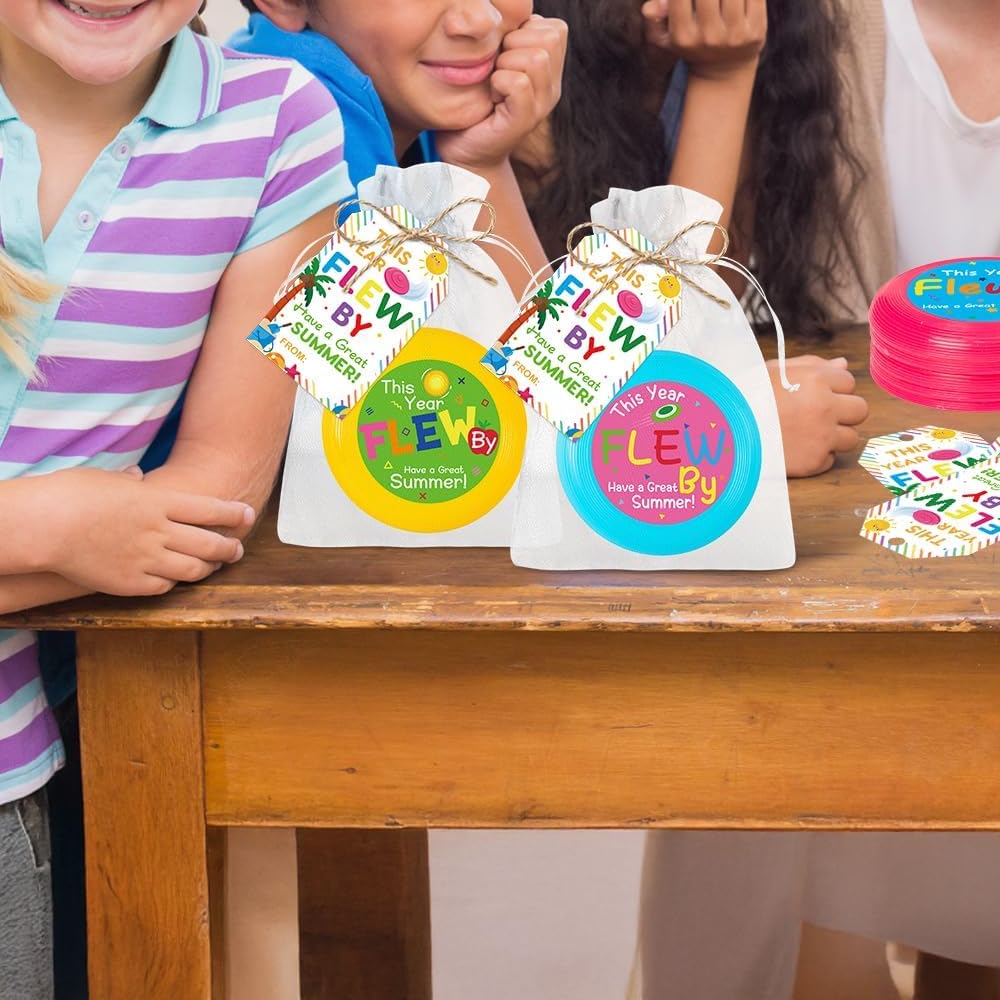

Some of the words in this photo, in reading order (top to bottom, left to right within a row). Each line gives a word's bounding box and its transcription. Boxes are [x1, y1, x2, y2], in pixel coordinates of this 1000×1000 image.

[377, 228, 412, 265] THIS
[611, 251, 645, 288] THIS
[941, 269, 977, 277] This
[322, 251, 413, 330] FLEW
[331, 301, 372, 337] BY
[555, 274, 646, 352] FLEW
[279, 337, 307, 363] FROM:
[293, 303, 323, 331] Have
[324, 331, 333, 340] a
[335, 338, 368, 369] Great
[564, 324, 605, 360] BY
[291, 321, 362, 384] SUMMER!
[526, 325, 556, 354] Have
[557, 354, 566, 363] a
[568, 361, 601, 392] Great
[381, 379, 415, 394] This
[512, 360, 540, 387] FROM:
[524, 344, 595, 407] SUMMER!
[404, 395, 444, 411] Year
[609, 393, 644, 417] This
[646, 384, 686, 402] Year
[359, 406, 477, 460] FLEW
[471, 431, 497, 455] By
[601, 428, 726, 466] FLEW
[882, 456, 928, 470] YEAR
[885, 443, 932, 458] THIS
[390, 473, 467, 489] Summer!
[403, 465, 427, 474] Have
[438, 465, 465, 474] Great
[608, 481, 635, 493] Have
[637, 483, 644, 492] a
[647, 481, 678, 493] Great
[679, 465, 717, 505] By
[631, 494, 695, 509] Summer!
[905, 525, 947, 546] THIS
[936, 522, 977, 543] YEAR
